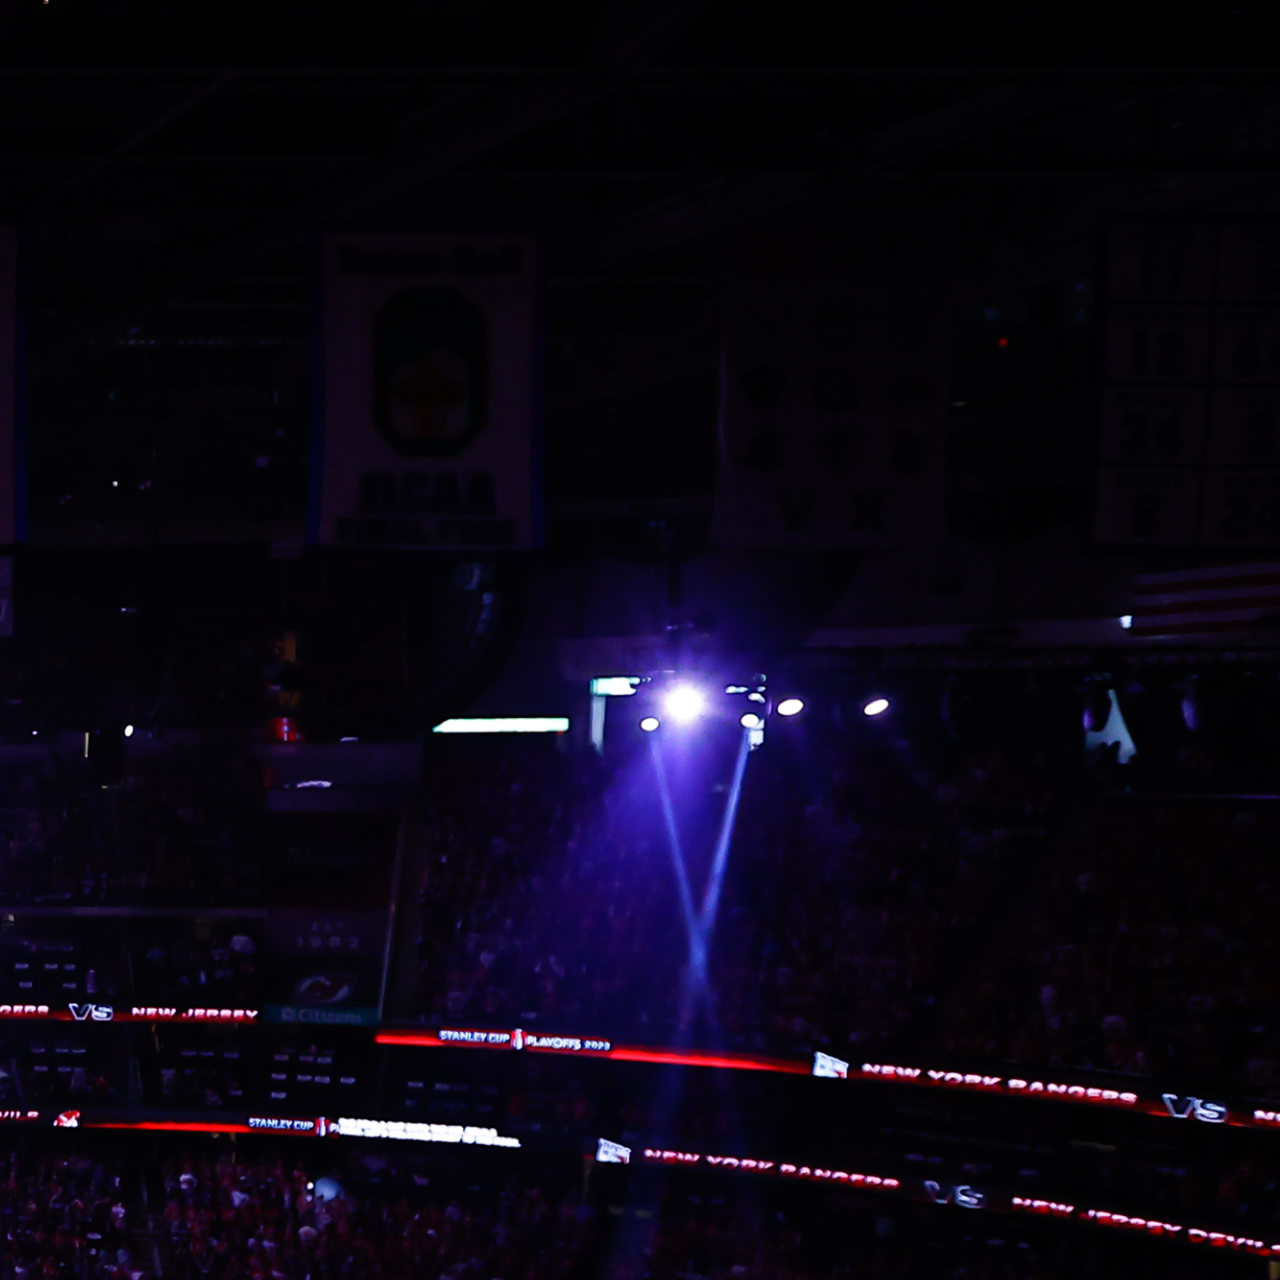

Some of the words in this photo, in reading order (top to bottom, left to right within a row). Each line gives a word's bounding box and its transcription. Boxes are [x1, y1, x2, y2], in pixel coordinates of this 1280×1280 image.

[67, 1001, 115, 1022] VS
[131, 1006, 177, 1020] NEW
[181, 1006, 259, 1022] JERSEY
[439, 1029, 487, 1043] STANLEY
[488, 1032, 510, 1044] CUP
[526, 1034, 582, 1050] PLAYOFFS
[861, 1062, 921, 1079] NEW
[926, 1068, 1002, 1087] YORK
[1006, 1078, 1139, 1104] RANGERS
[1161, 1092, 1229, 1124] VS
[248, 1116, 293, 1131] STANLEY
[294, 1119, 314, 1132] CUP
